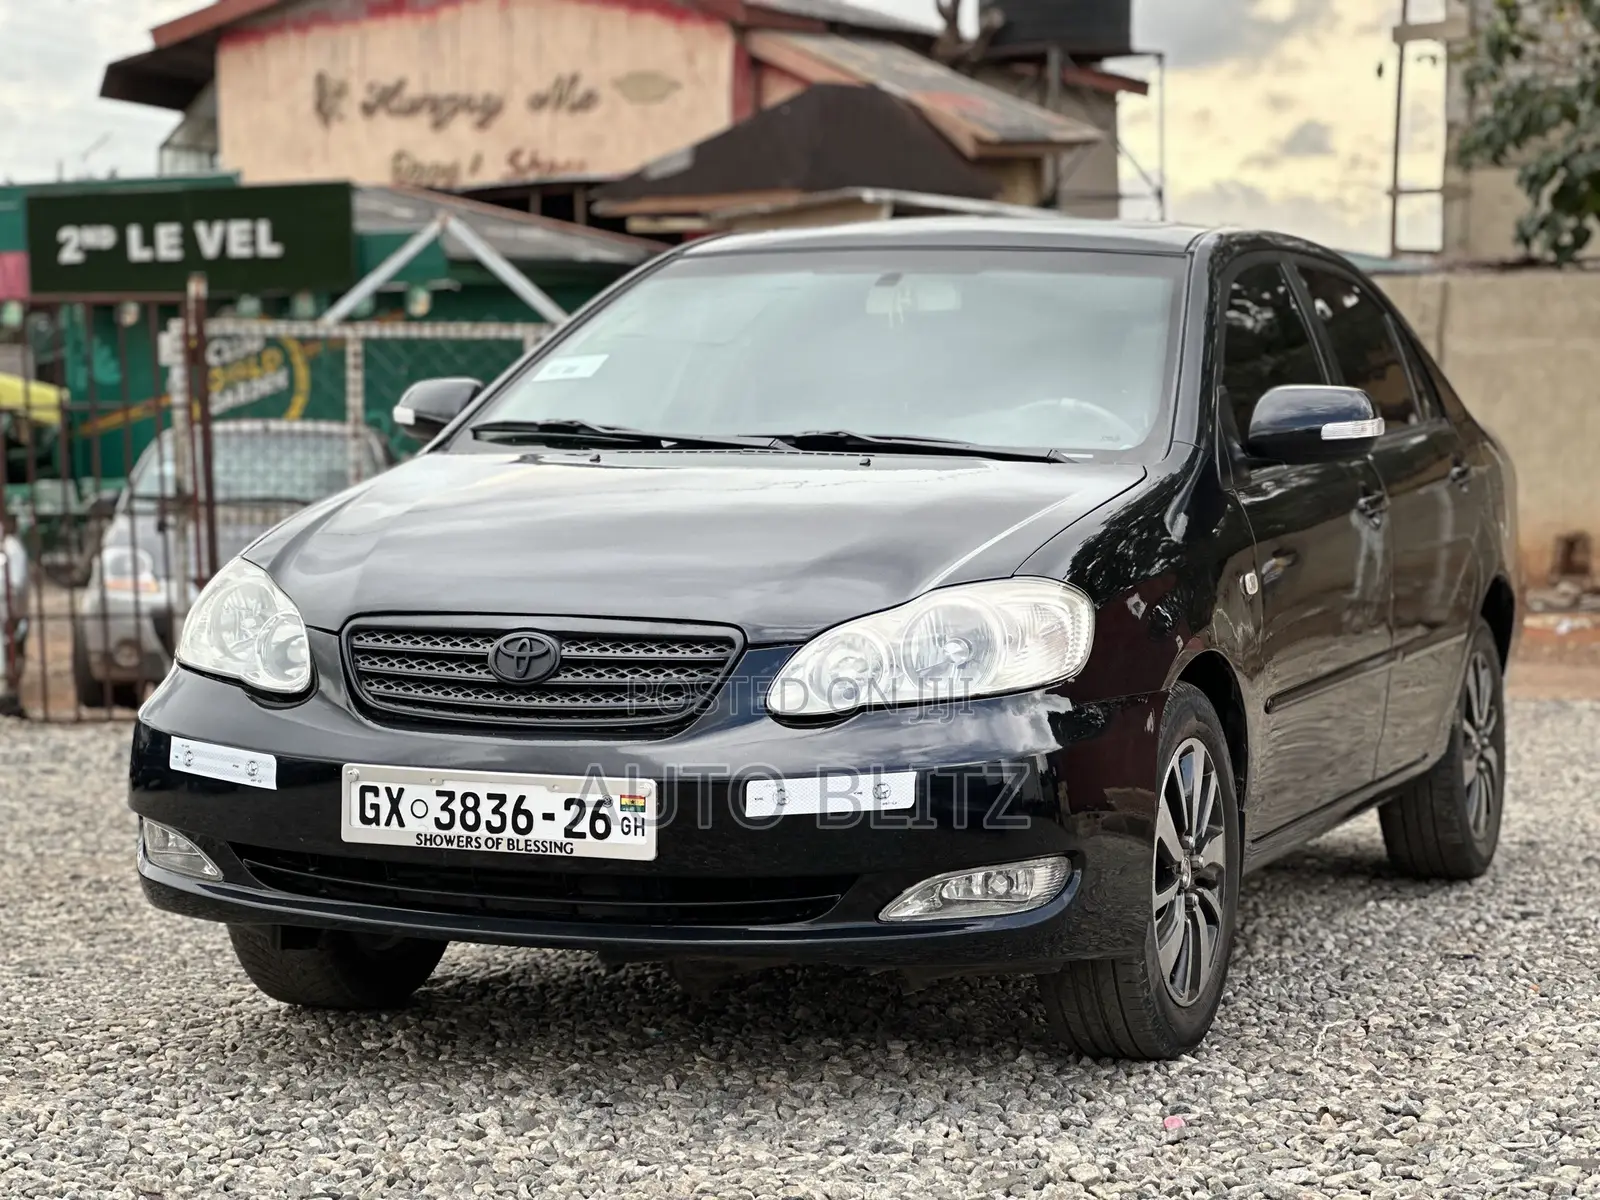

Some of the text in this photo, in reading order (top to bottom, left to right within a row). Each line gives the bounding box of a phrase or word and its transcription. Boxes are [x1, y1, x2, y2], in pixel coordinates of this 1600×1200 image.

[56, 218, 284, 265] 2ND LE VEL
[358, 784, 406, 828] GX
[415, 832, 575, 856] SHOWERS OF BLESSING
[620, 816, 646, 838] GH
